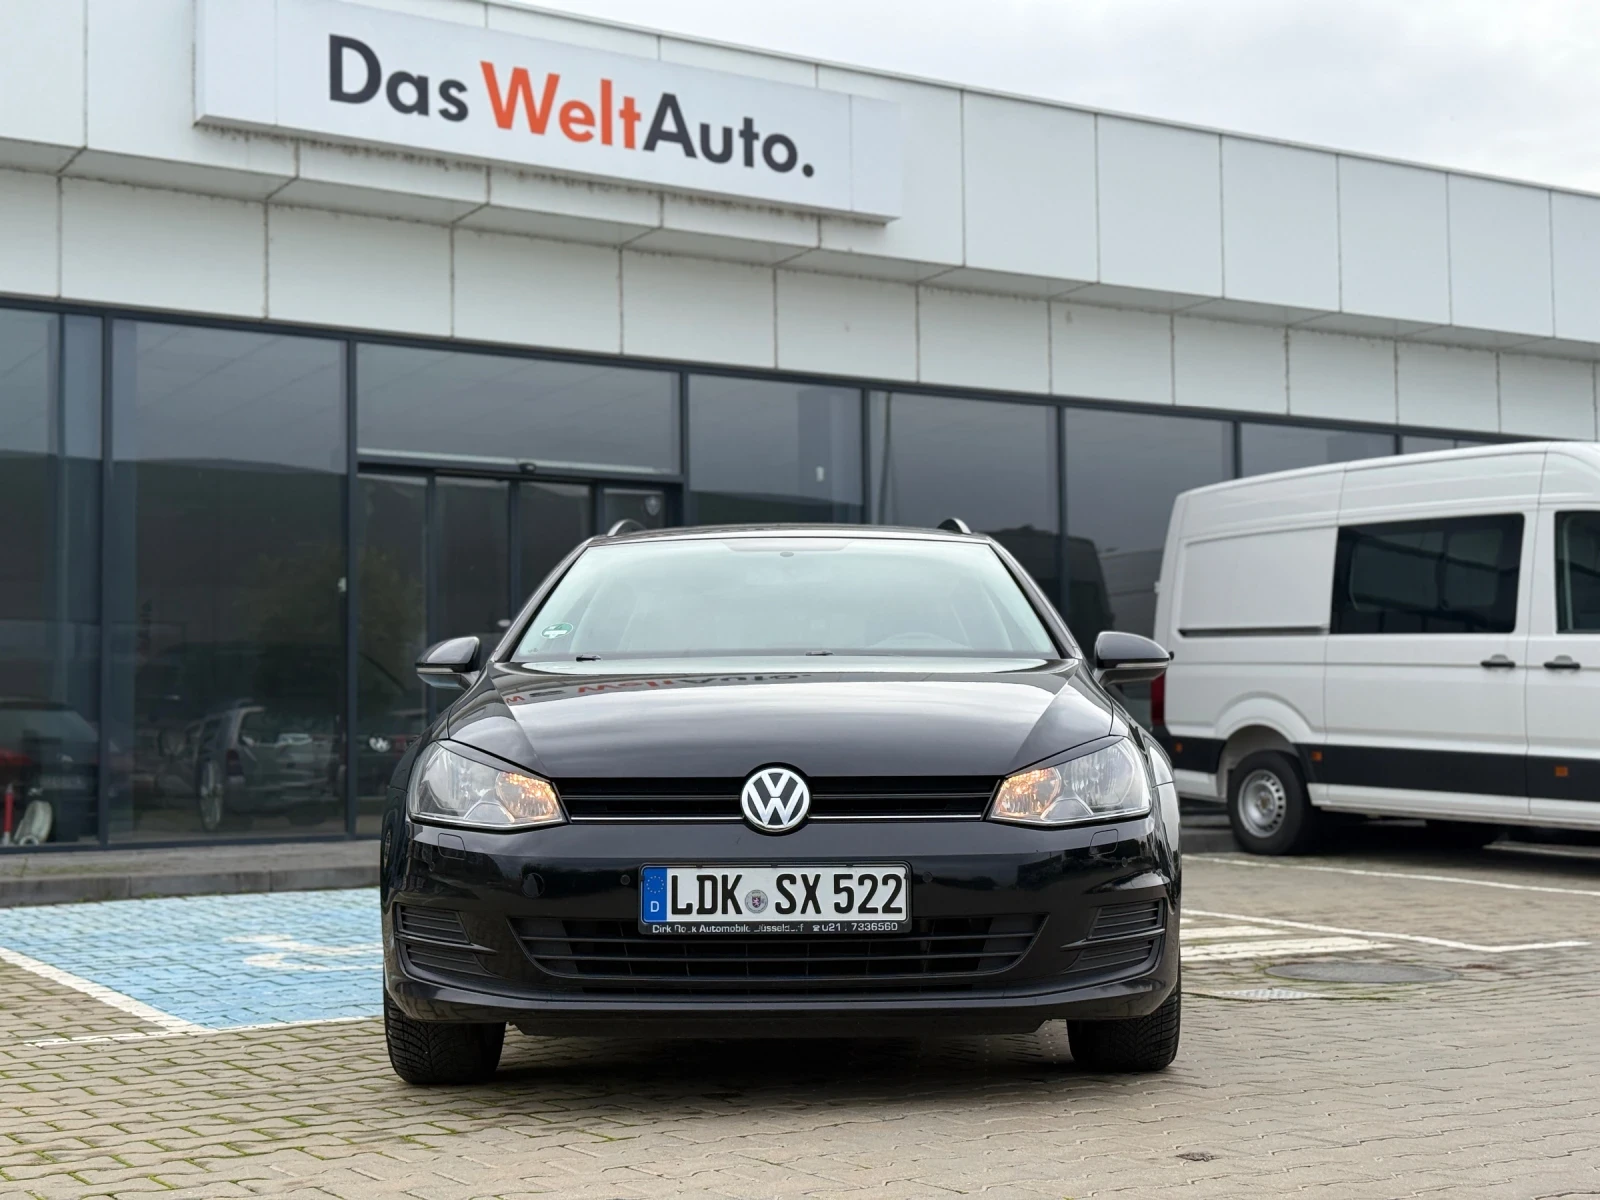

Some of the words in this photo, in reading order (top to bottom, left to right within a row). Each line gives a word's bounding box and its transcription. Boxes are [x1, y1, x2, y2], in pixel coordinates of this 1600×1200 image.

[328, 34, 469, 122] Das
[481, 61, 814, 178] WeltAuto.
[650, 900, 660, 913] D
[671, 874, 743, 915] LDK
[775, 873, 822, 915] SX
[833, 873, 903, 915] 522
